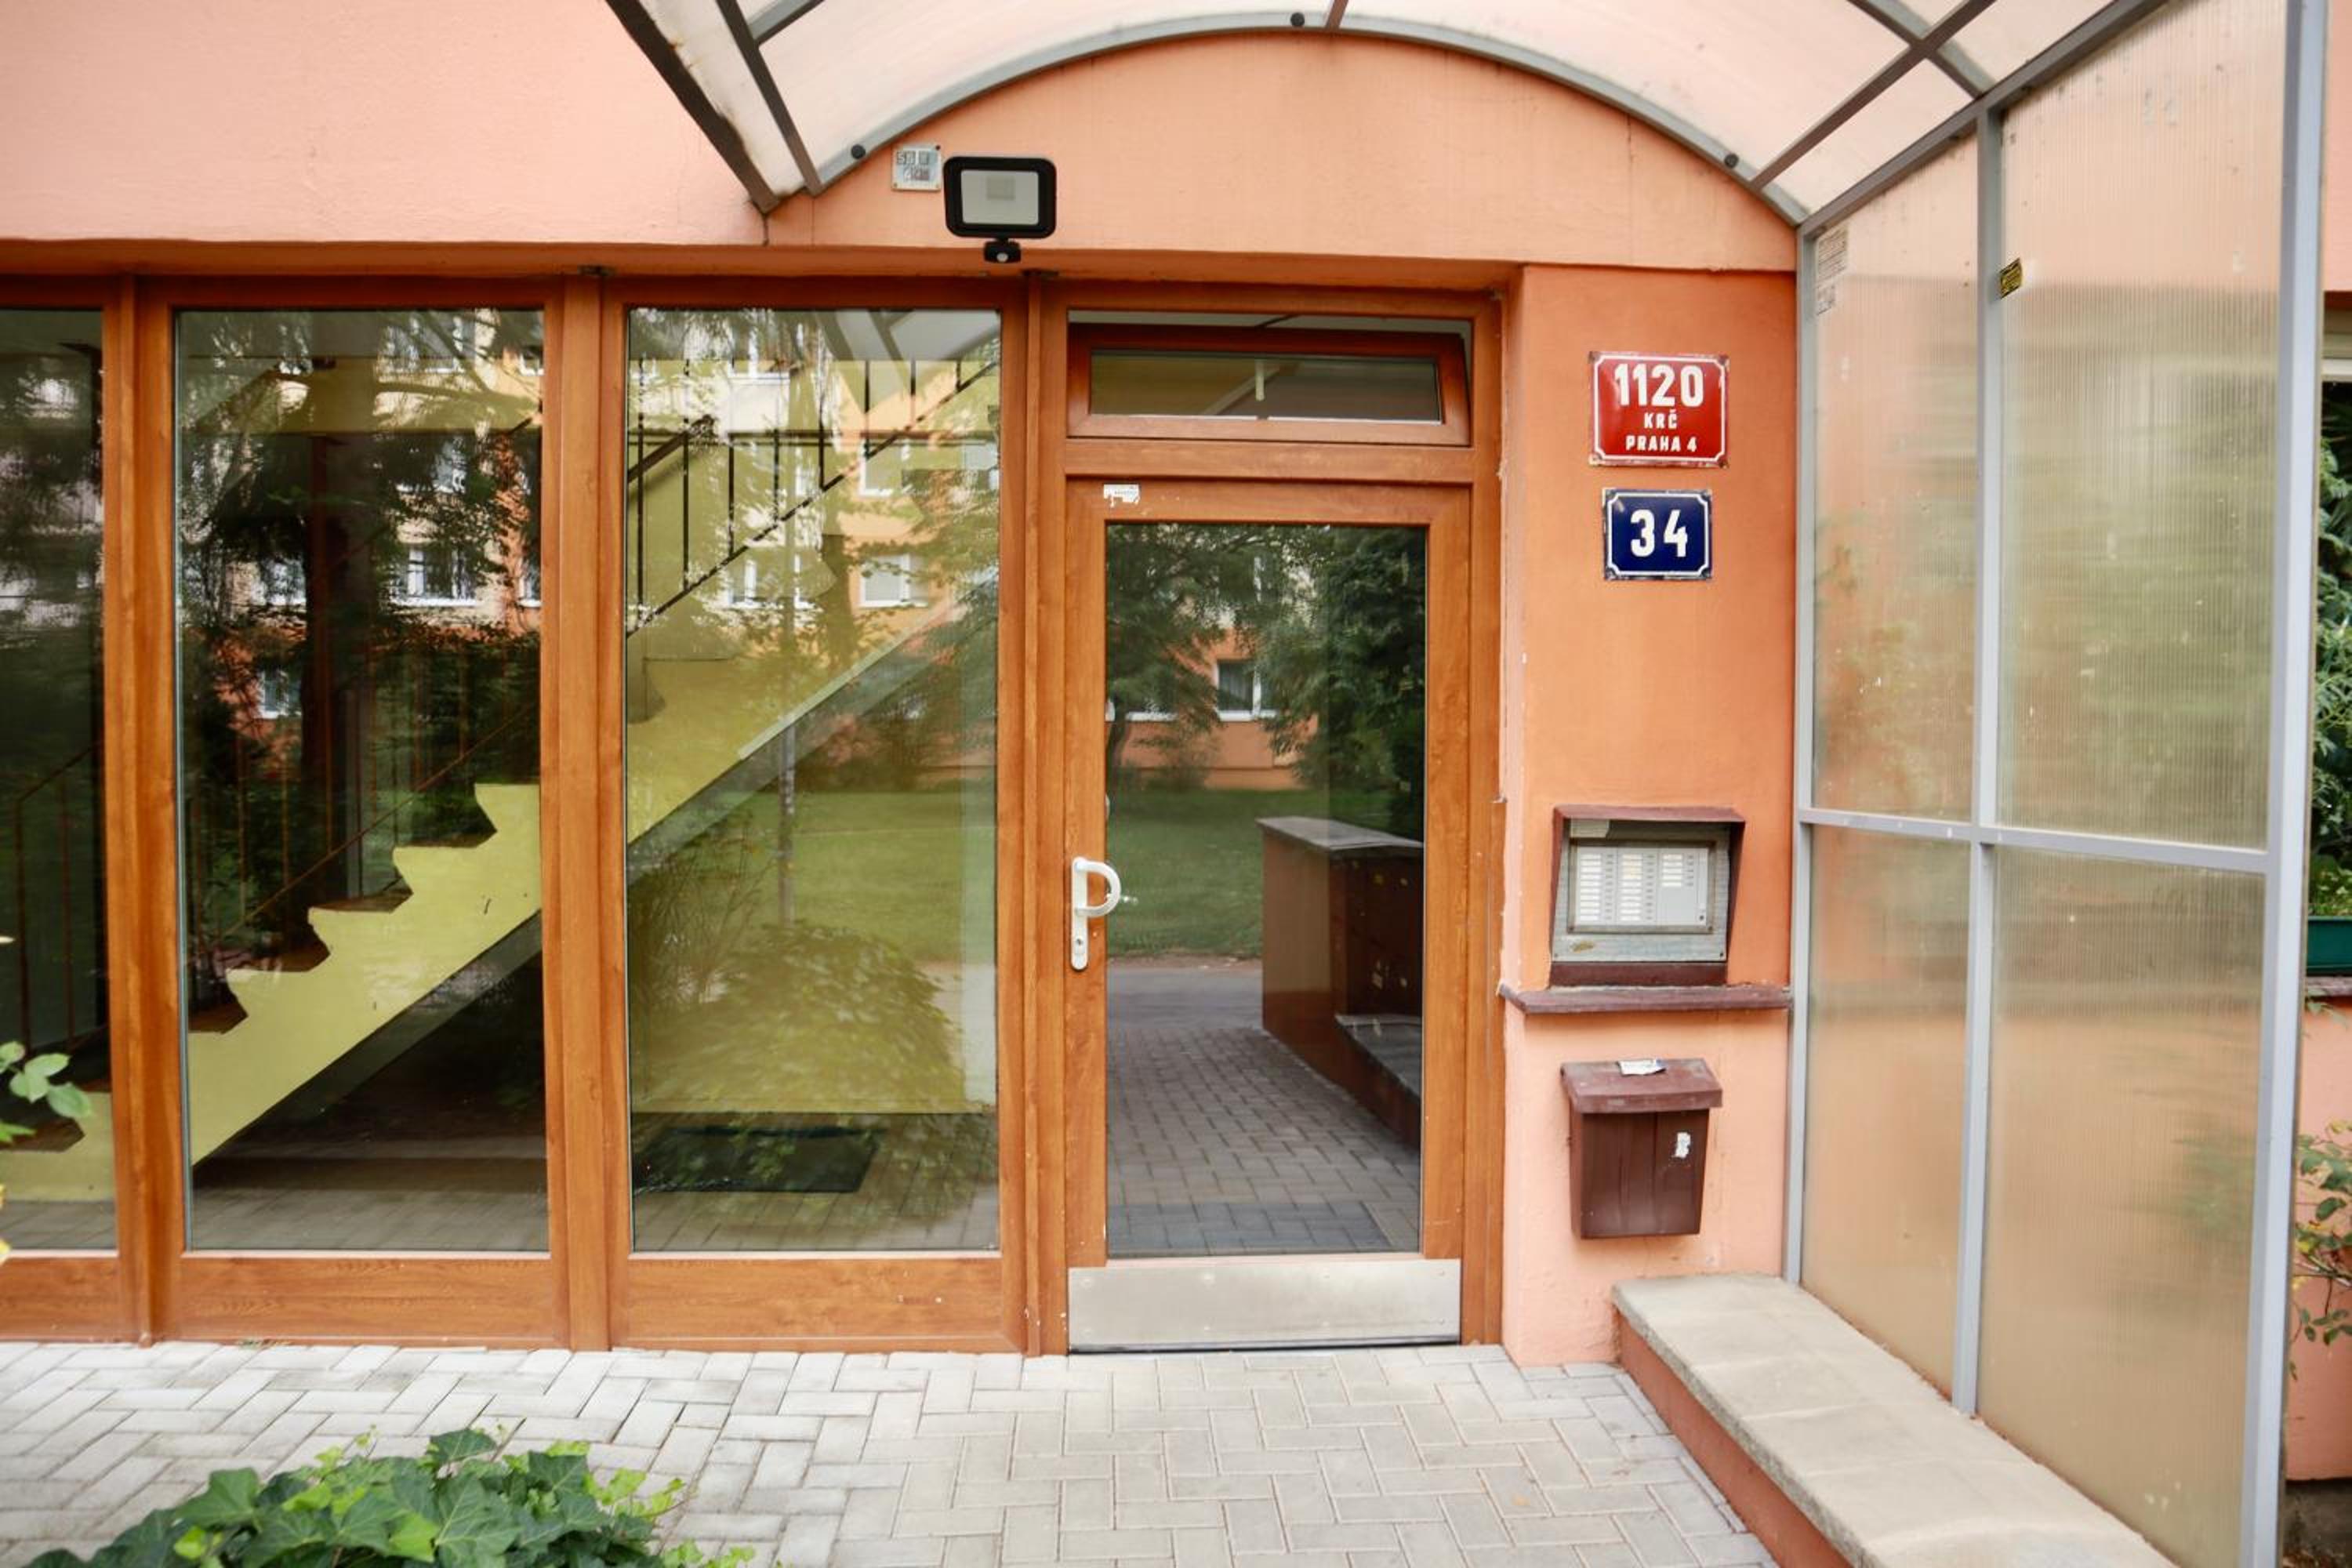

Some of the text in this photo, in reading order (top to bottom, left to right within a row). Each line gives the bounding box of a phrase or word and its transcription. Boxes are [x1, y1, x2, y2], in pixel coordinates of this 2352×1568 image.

[1614, 363, 1704, 407] 1120
[1644, 408, 1678, 429] KRČ
[1625, 435, 1697, 452] PRAHA 4
[1630, 509, 1688, 557] 34
